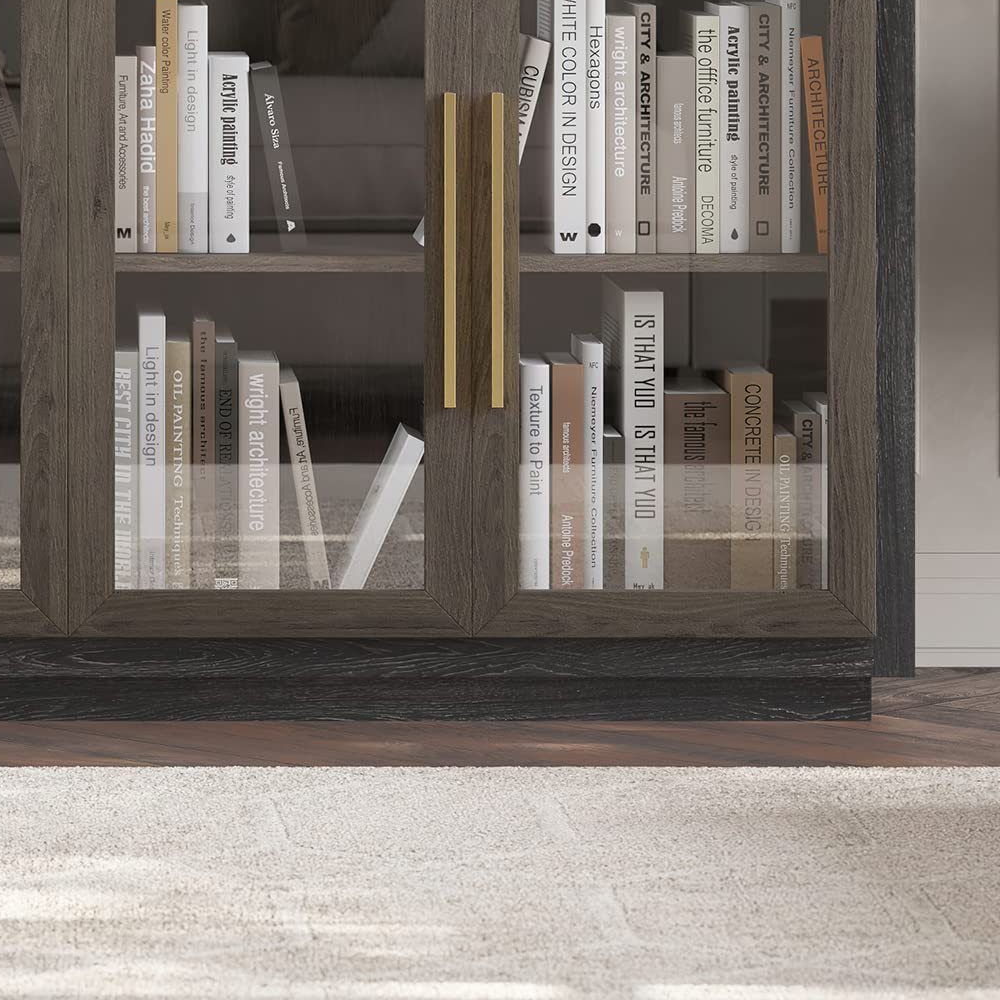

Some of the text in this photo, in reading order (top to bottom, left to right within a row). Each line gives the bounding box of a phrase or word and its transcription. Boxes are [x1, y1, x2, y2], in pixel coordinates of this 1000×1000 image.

[160, 9, 170, 95] Water color Painting
[185, 30, 198, 133] Light in design
[562, 46, 576, 106] COLOR
[587, 25, 602, 110] Hexagons
[612, 26, 627, 178] wright architecture
[641, 11, 650, 196] CITY ARCHITECTURE
[726, 25, 739, 181] Acrylic painting of
[118, 112, 128, 190] Art and Accessories
[140, 60, 155, 174] Zaha Hadid
[220, 73, 238, 166] Acrylic painting
[264, 92, 280, 150] Álvaro Siza
[562, 111, 576, 127] IN
[698, 28, 717, 245] the furniture DECOMA
[759, 13, 769, 196] CITY ARCHITECTURE
[562, 132, 576, 197] DESIGN
[143, 346, 159, 467] Light in design
[173, 369, 182, 488] OIL PAINTING
[245, 373, 268, 532] wright architecture
[529, 385, 542, 496] Texture to Paint
[634, 314, 655, 519] IS THAT YUO IS THAT YUO
[745, 383, 761, 483] CONCRETE IN
[802, 418, 812, 449] CITY
[779, 454, 790, 475] OIL
